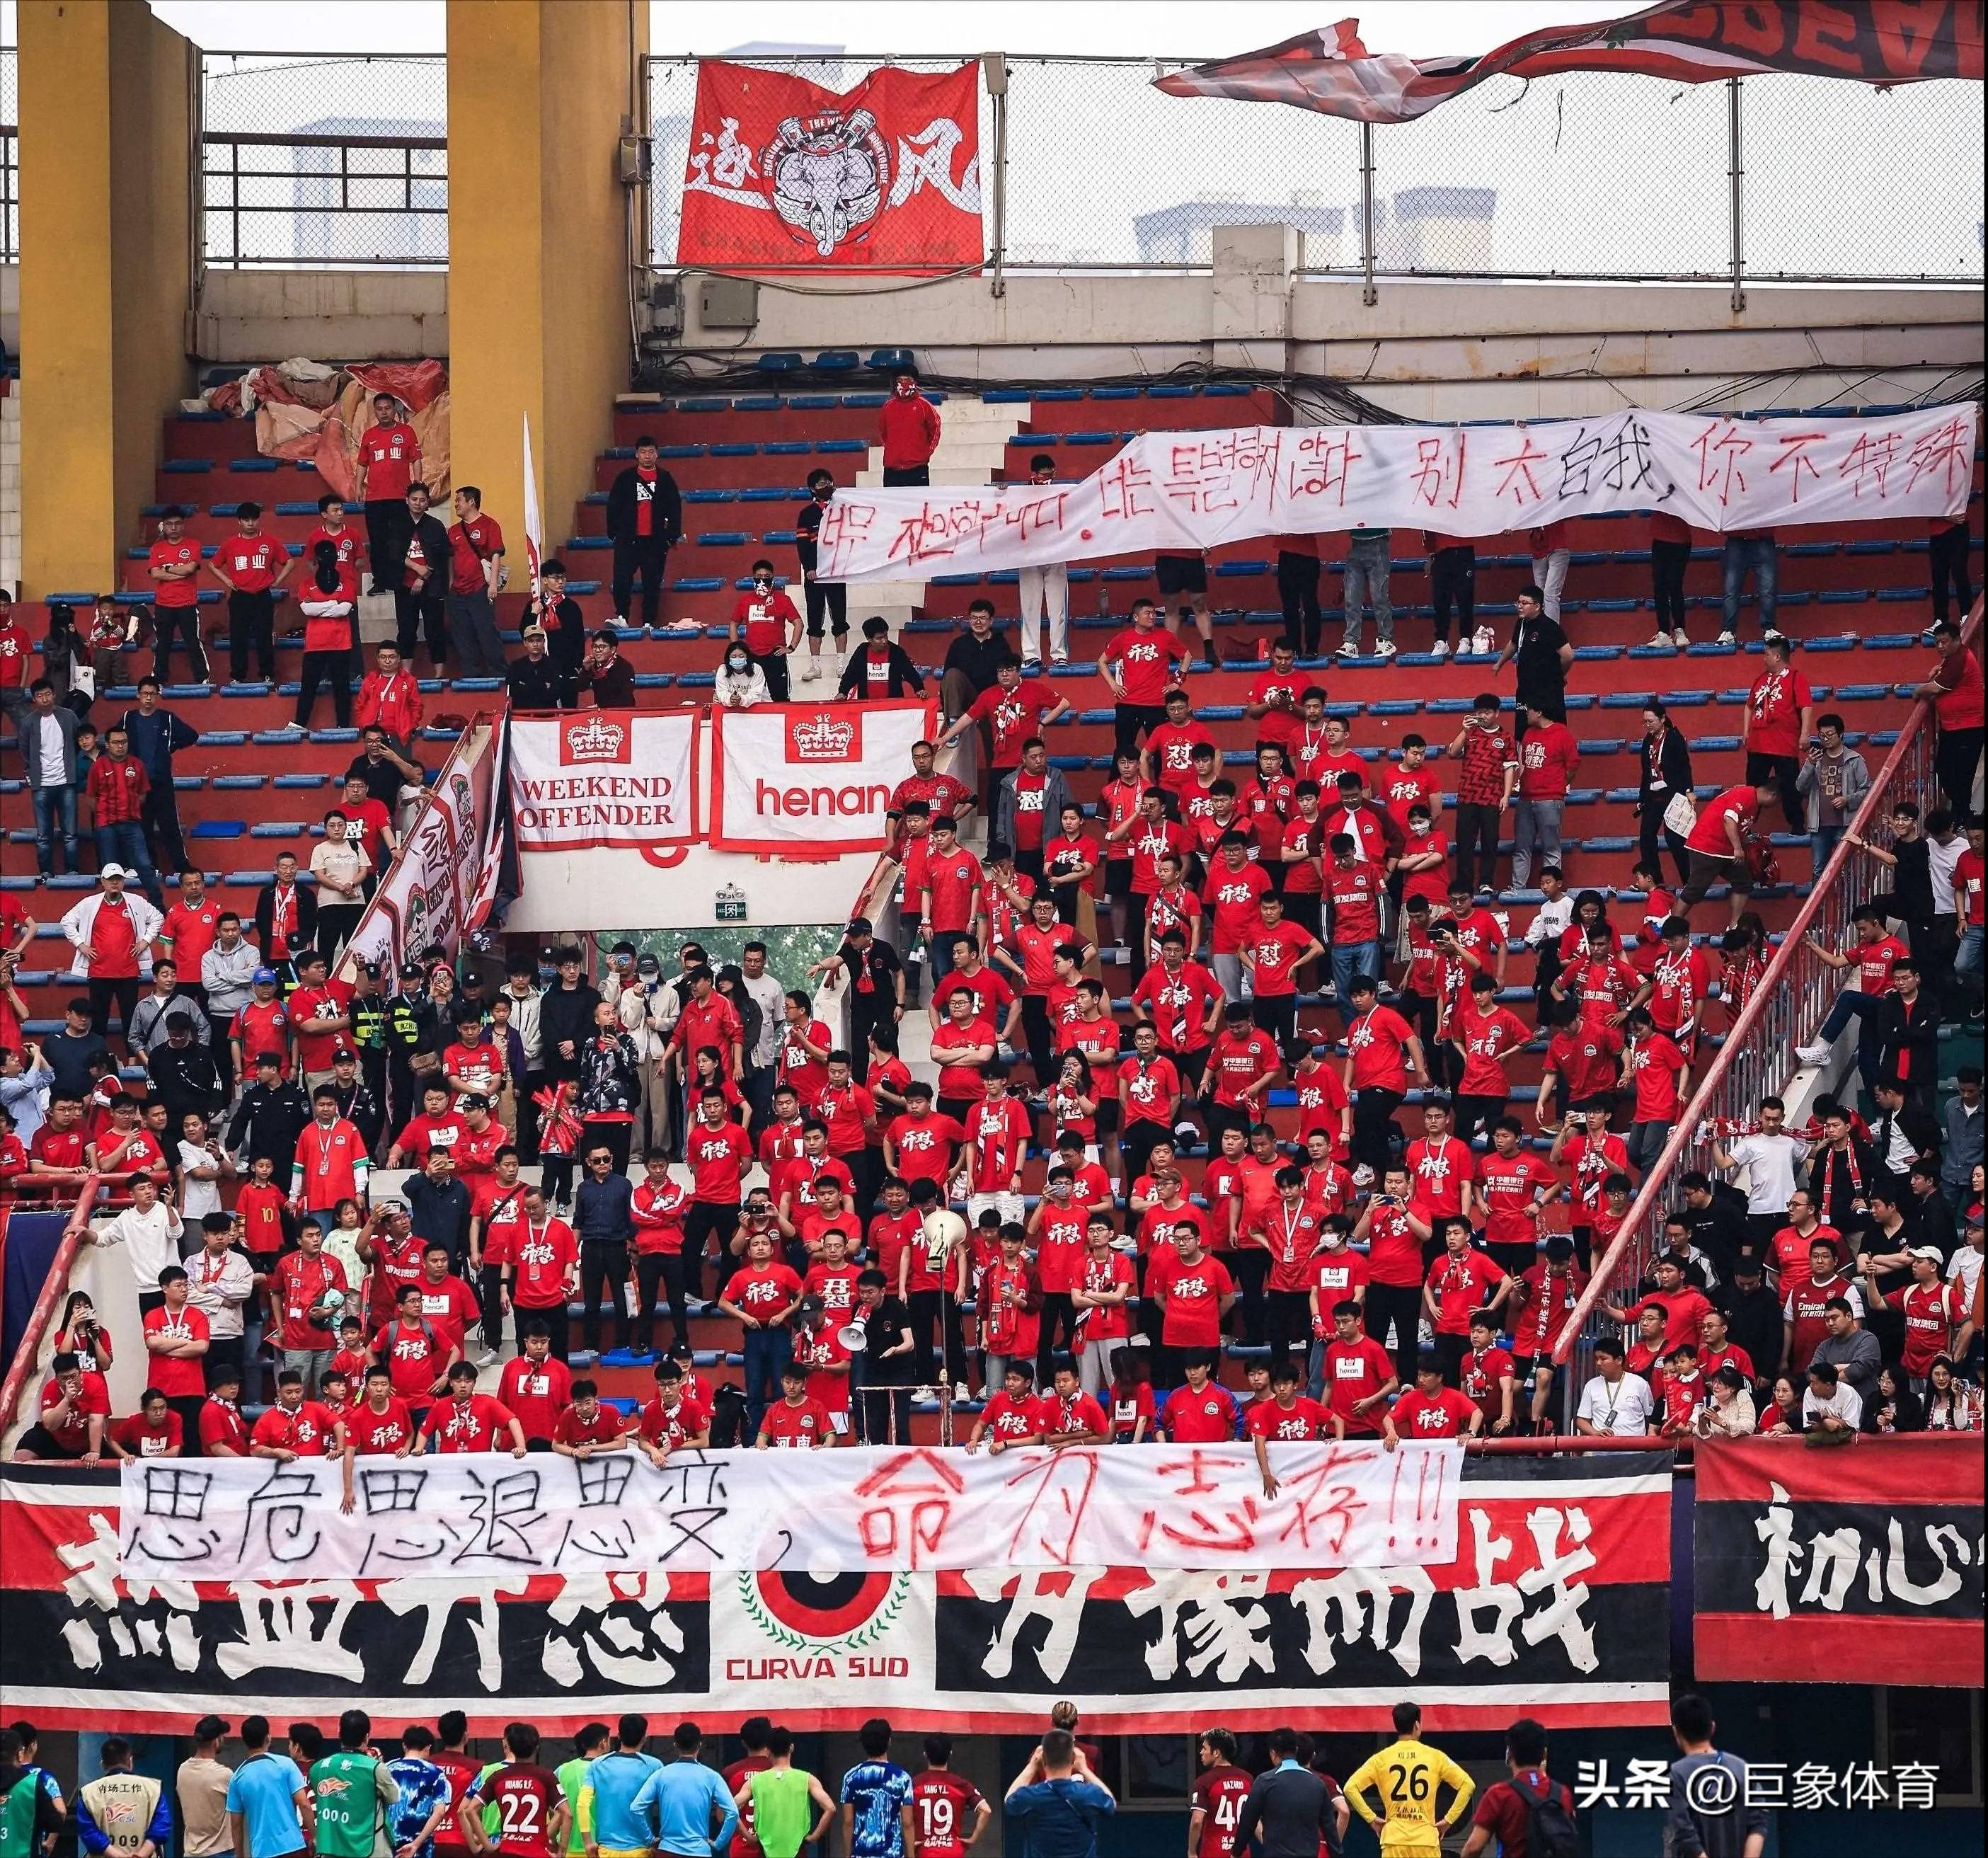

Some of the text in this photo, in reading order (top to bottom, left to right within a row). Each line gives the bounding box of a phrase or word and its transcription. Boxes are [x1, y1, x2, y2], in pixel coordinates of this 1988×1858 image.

[808, 118, 825, 130] THE
[1099, 457, 1154, 519] 너는
[234, 554, 266, 570] 建业
[520, 776, 672, 803] WEEKEND
[757, 778, 891, 817] henan
[517, 804, 675, 830] OFFENDER
[1469, 1038, 1495, 1055] 河南
[435, 1135, 456, 1145] henan
[1072, 1179, 1090, 1198] 怼
[261, 1207, 274, 1223] 10
[1798, 1302, 1826, 1311] Emirat
[815, 1342, 833, 1363] 怼
[776, 1435, 812, 1447] 河南
[1755, 1480, 1984, 1621] 初心
[726, 1656, 909, 1681] CURVA SUD
[505, 1779, 523, 1790] HUANG
[924, 1784, 938, 1794] YANG
[1223, 1780, 1244, 1790] NAZARIO
[1389, 1764, 1430, 1801] 26
[501, 1794, 539, 1834] 22
[919, 1799, 953, 1835] 19
